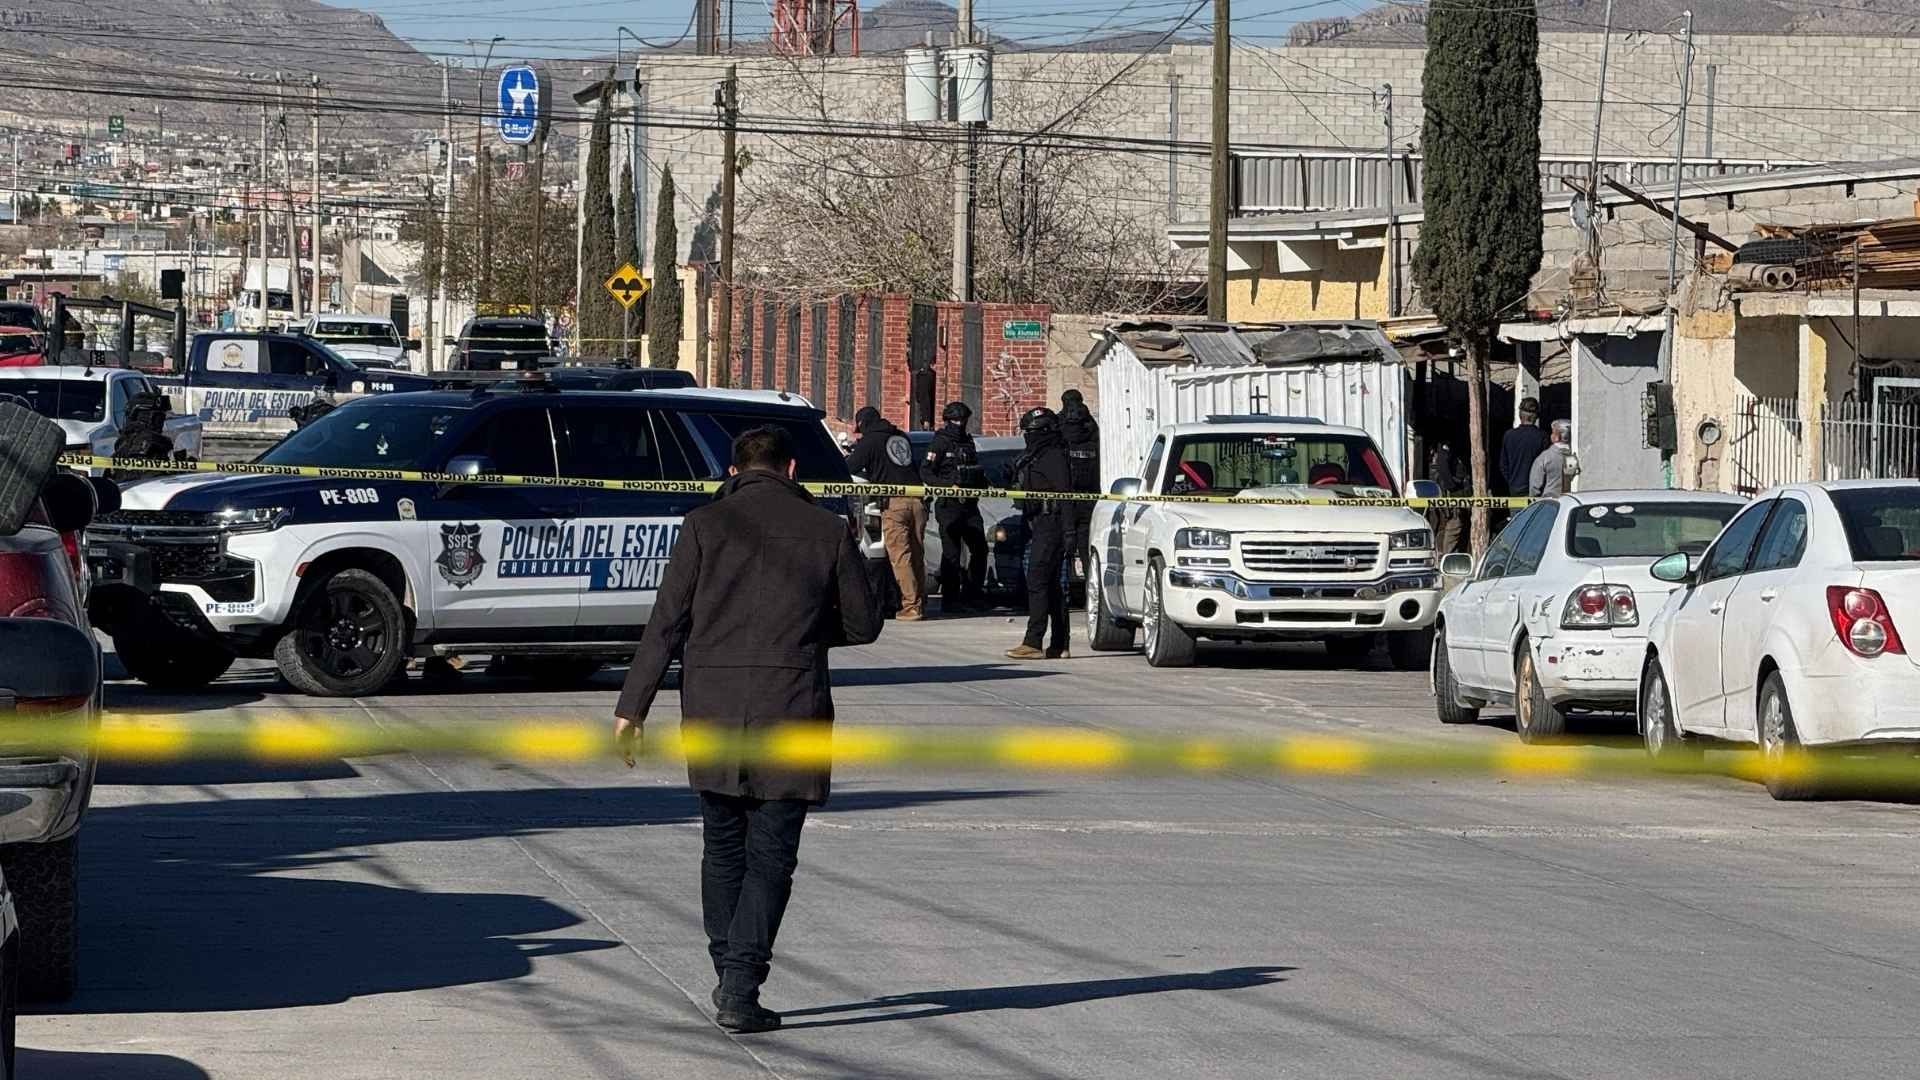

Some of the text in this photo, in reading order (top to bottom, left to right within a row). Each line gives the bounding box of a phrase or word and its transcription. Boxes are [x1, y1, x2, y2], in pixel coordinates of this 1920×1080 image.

[249, 392, 268, 409] DEL
[271, 392, 311, 409] ESTADO
[211, 408, 252, 422] SWAT
[216, 463, 300, 474] PRECAUCION
[319, 468, 402, 479] PRECAUCION
[622, 481, 704, 492] PRECAUCION
[824, 484, 906, 495] PRECAUCION
[924, 487, 1007, 498] PRECAUCION
[319, 487, 379, 505] PE-809
[1427, 499, 1509, 507] PRECAUCION
[448, 534, 473, 549] SSPE
[500, 520, 683, 560] POLICÍA DEL ESTAD
[500, 560, 591, 575] CHIHUAHUA
[607, 559, 669, 589] SWAT
[206, 603, 255, 613] PE-809
